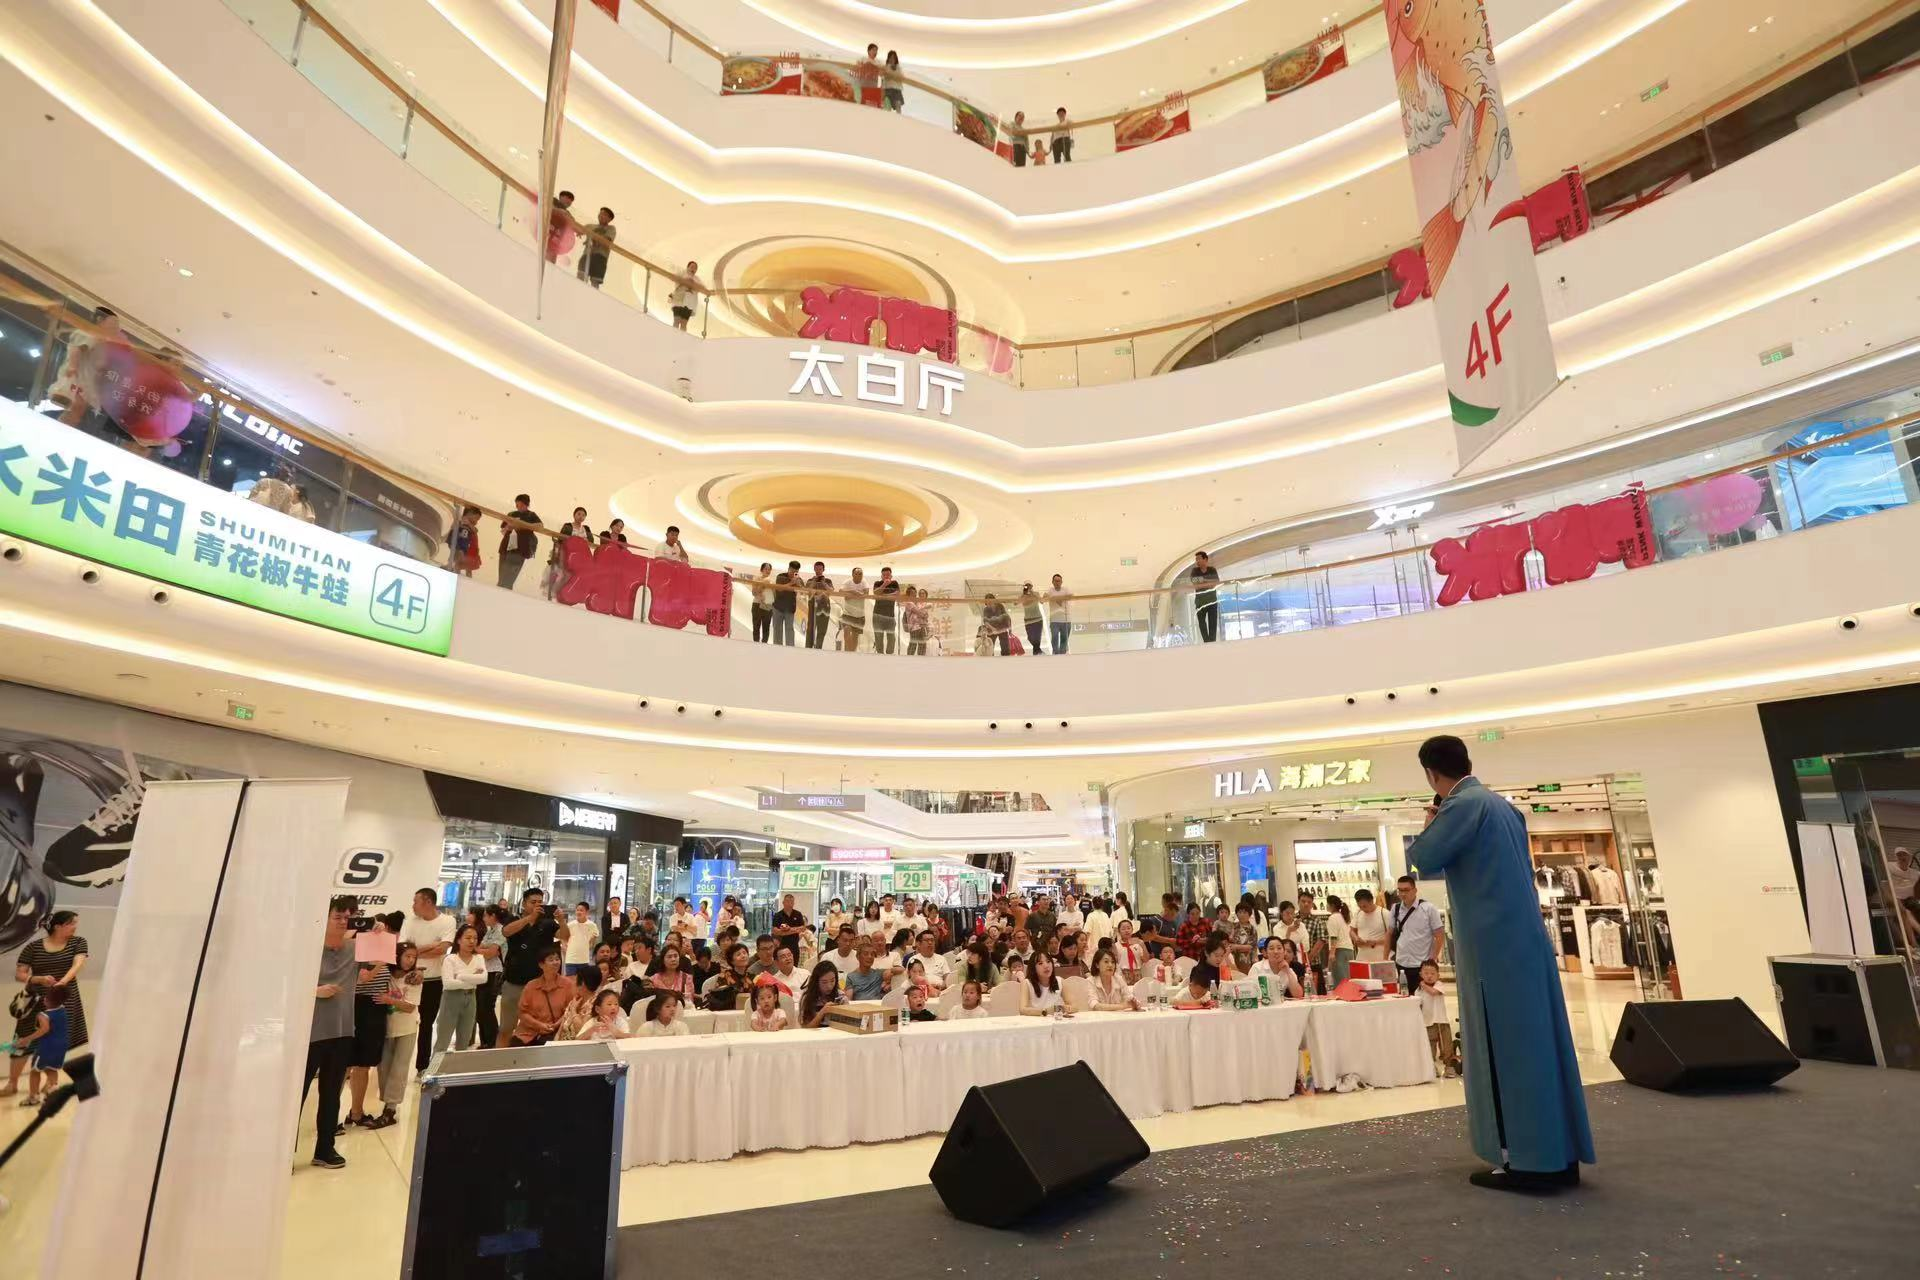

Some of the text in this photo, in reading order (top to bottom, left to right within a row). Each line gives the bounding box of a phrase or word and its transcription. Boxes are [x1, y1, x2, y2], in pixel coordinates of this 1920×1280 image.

[1465, 282, 1512, 379] 4F
[788, 344, 966, 415] 太白厅
[193, 531, 351, 607] 青花椒牛蛙
[199, 510, 351, 574] SHUIMITIAN
[376, 578, 425, 620] 4F
[1215, 768, 1273, 797] HLA
[342, 852, 385, 885] S
